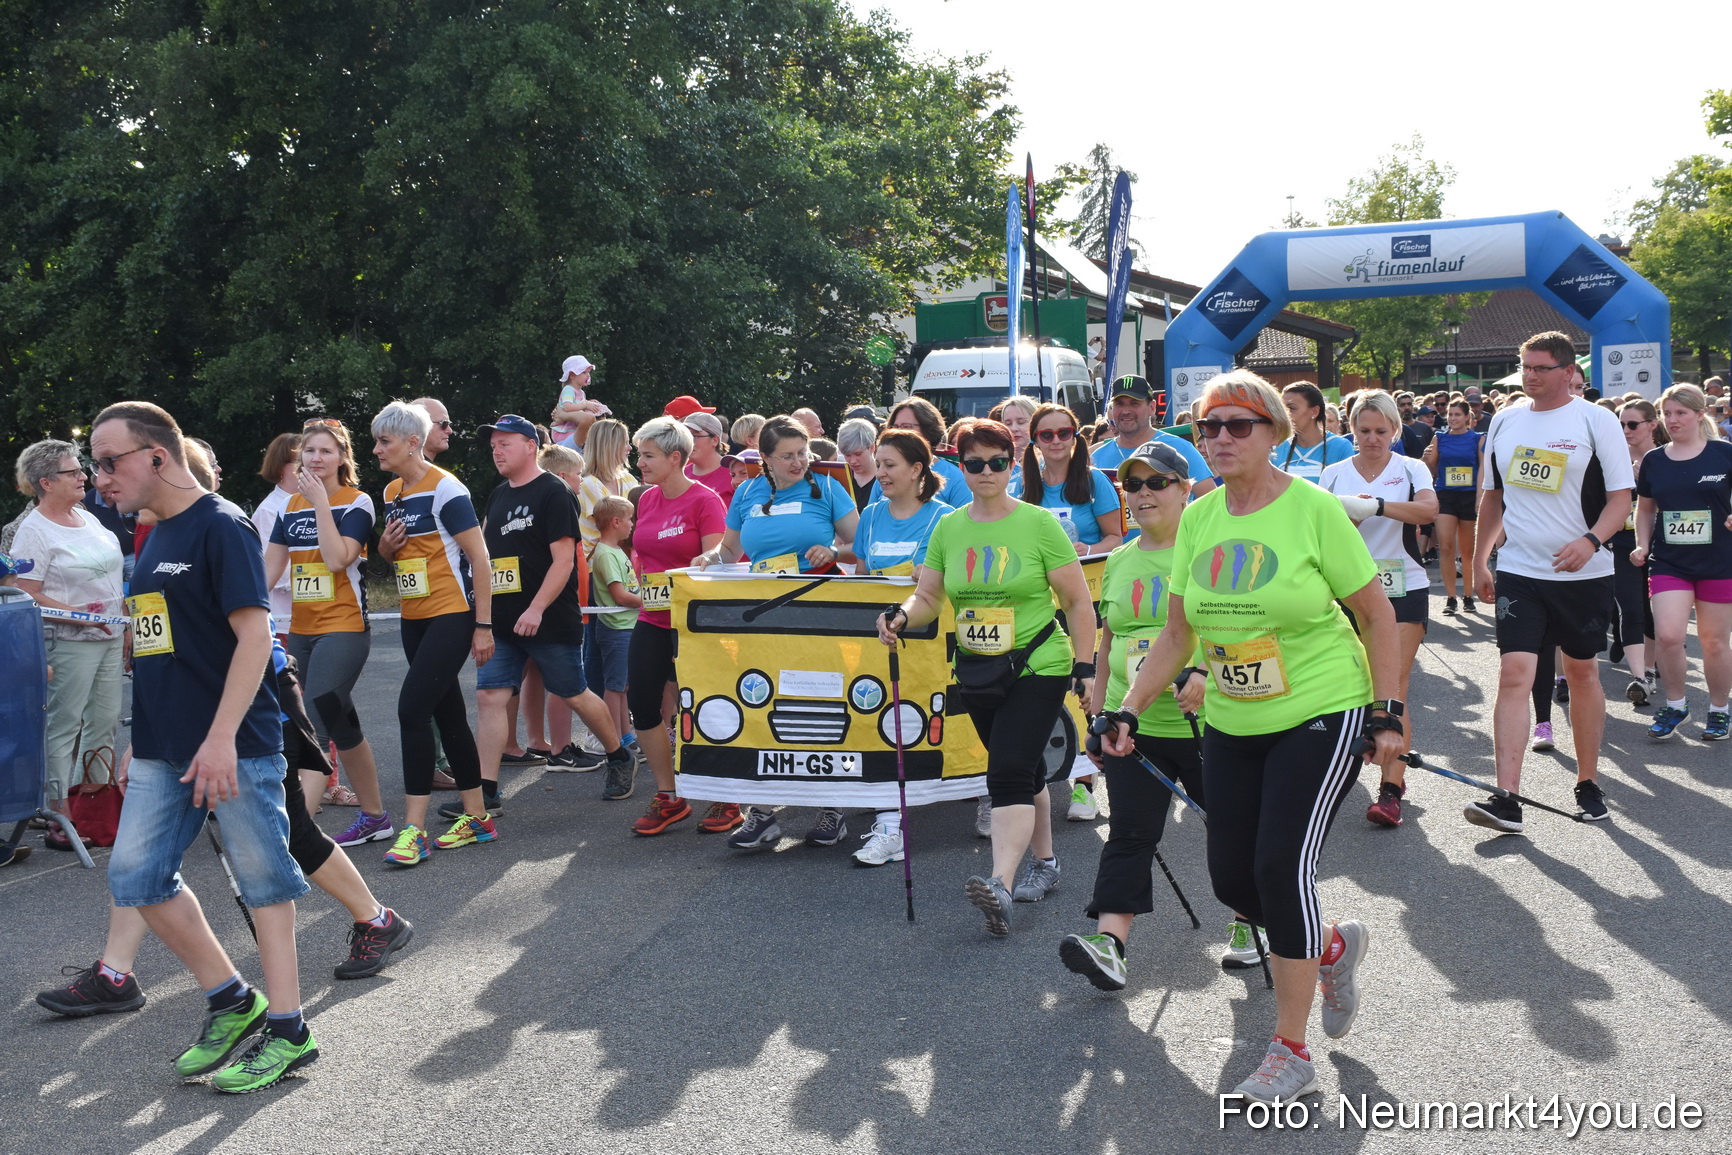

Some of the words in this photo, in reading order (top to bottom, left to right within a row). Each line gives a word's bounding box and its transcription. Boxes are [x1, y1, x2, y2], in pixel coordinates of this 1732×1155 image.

[1400, 241, 1429, 251] Fischer
[1377, 255, 1466, 276] firmenlauf
[1213, 296, 1260, 309] Fischer
[924, 369, 958, 379] abavent
[1451, 473, 1466, 481] 861
[1519, 461, 1551, 480] 960
[1669, 523, 1705, 535] 2447
[297, 577, 319, 591] 771
[492, 569, 514, 585] 176
[642, 586, 670, 600] 2174
[967, 625, 1000, 642] 444
[1221, 662, 1262, 685] 457
[1247, 684, 1272, 692] Christa
[762, 752, 834, 775] NM-GS
